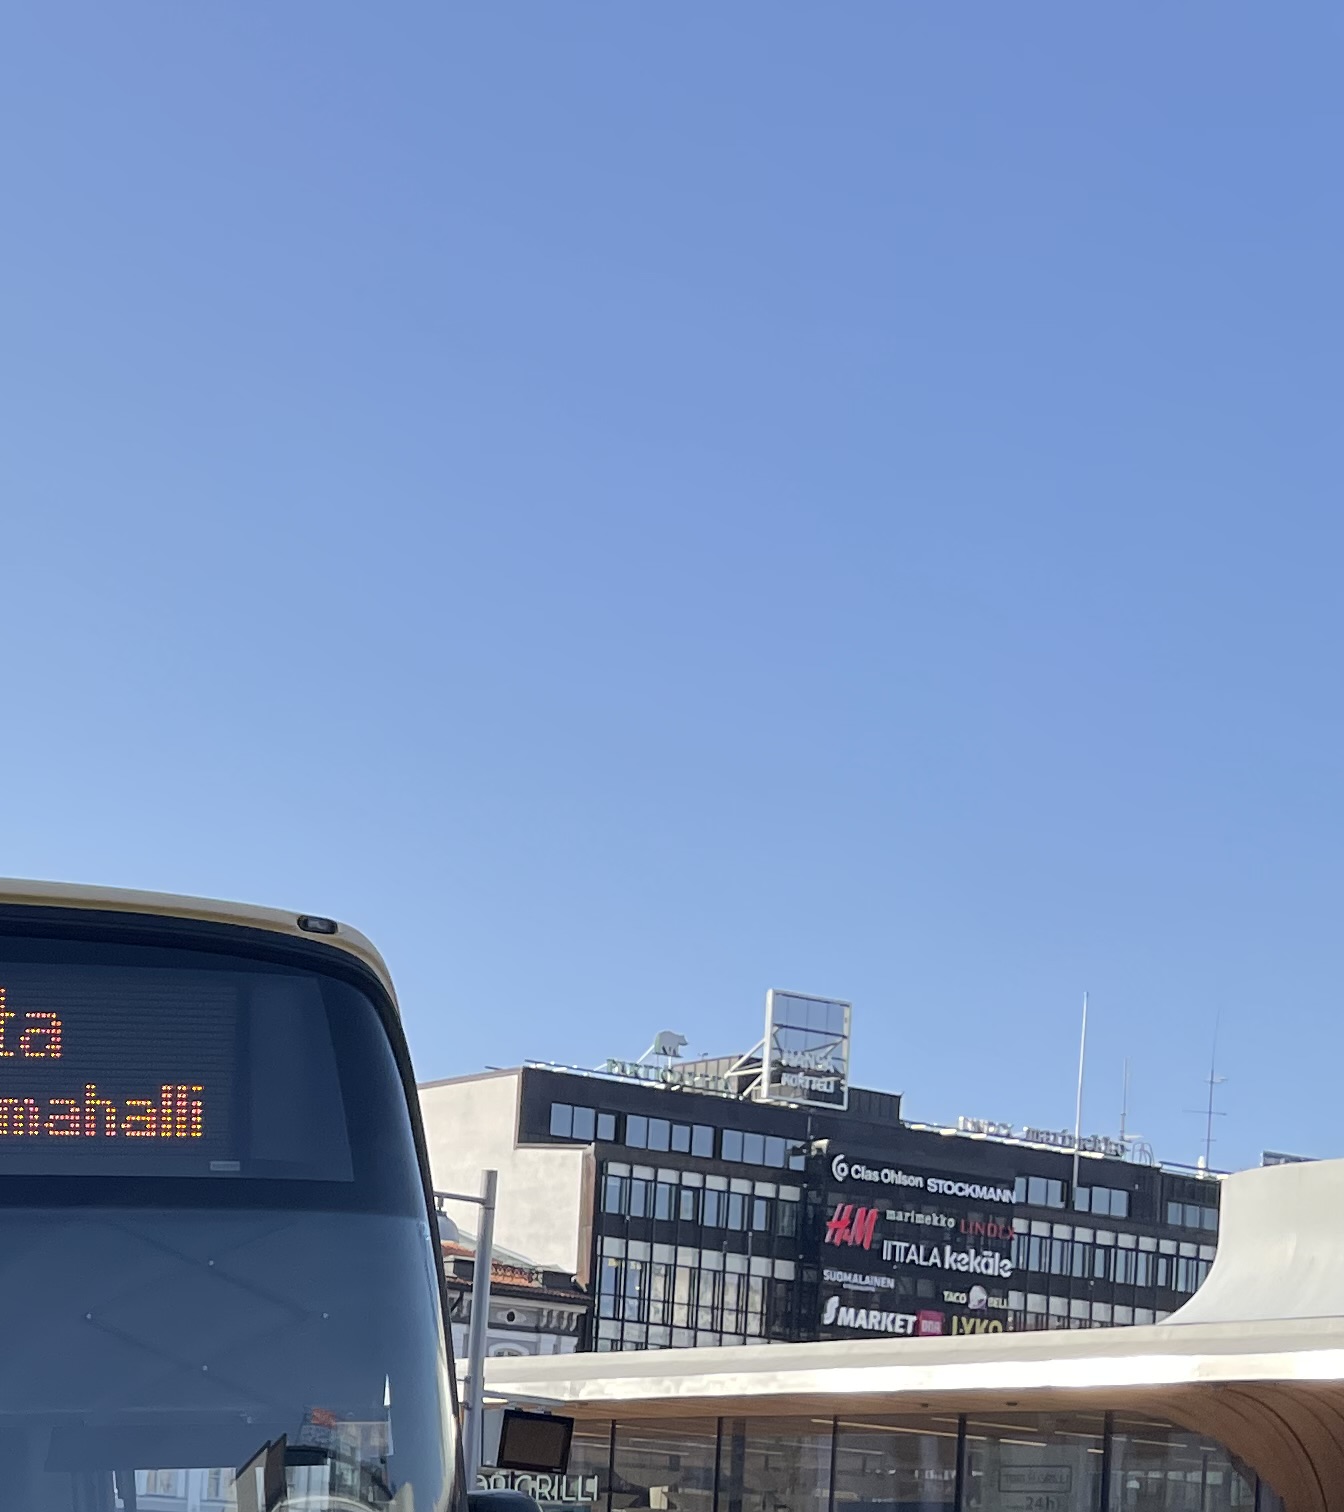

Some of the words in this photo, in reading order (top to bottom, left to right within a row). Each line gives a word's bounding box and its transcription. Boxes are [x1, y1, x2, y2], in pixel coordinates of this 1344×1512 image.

[851, 1164, 880, 1183] Clas
[881, 1168, 924, 1189] Ohlson
[927, 1177, 1016, 1204] STOCKMANN
[886, 1209, 956, 1228] marimekko
[960, 1219, 1016, 1241] LINDEX
[822, 1268, 895, 1290] SUOMALAINEN
[837, 1306, 917, 1335] MARKET
[515, 1474, 599, 1502] GRILLI
